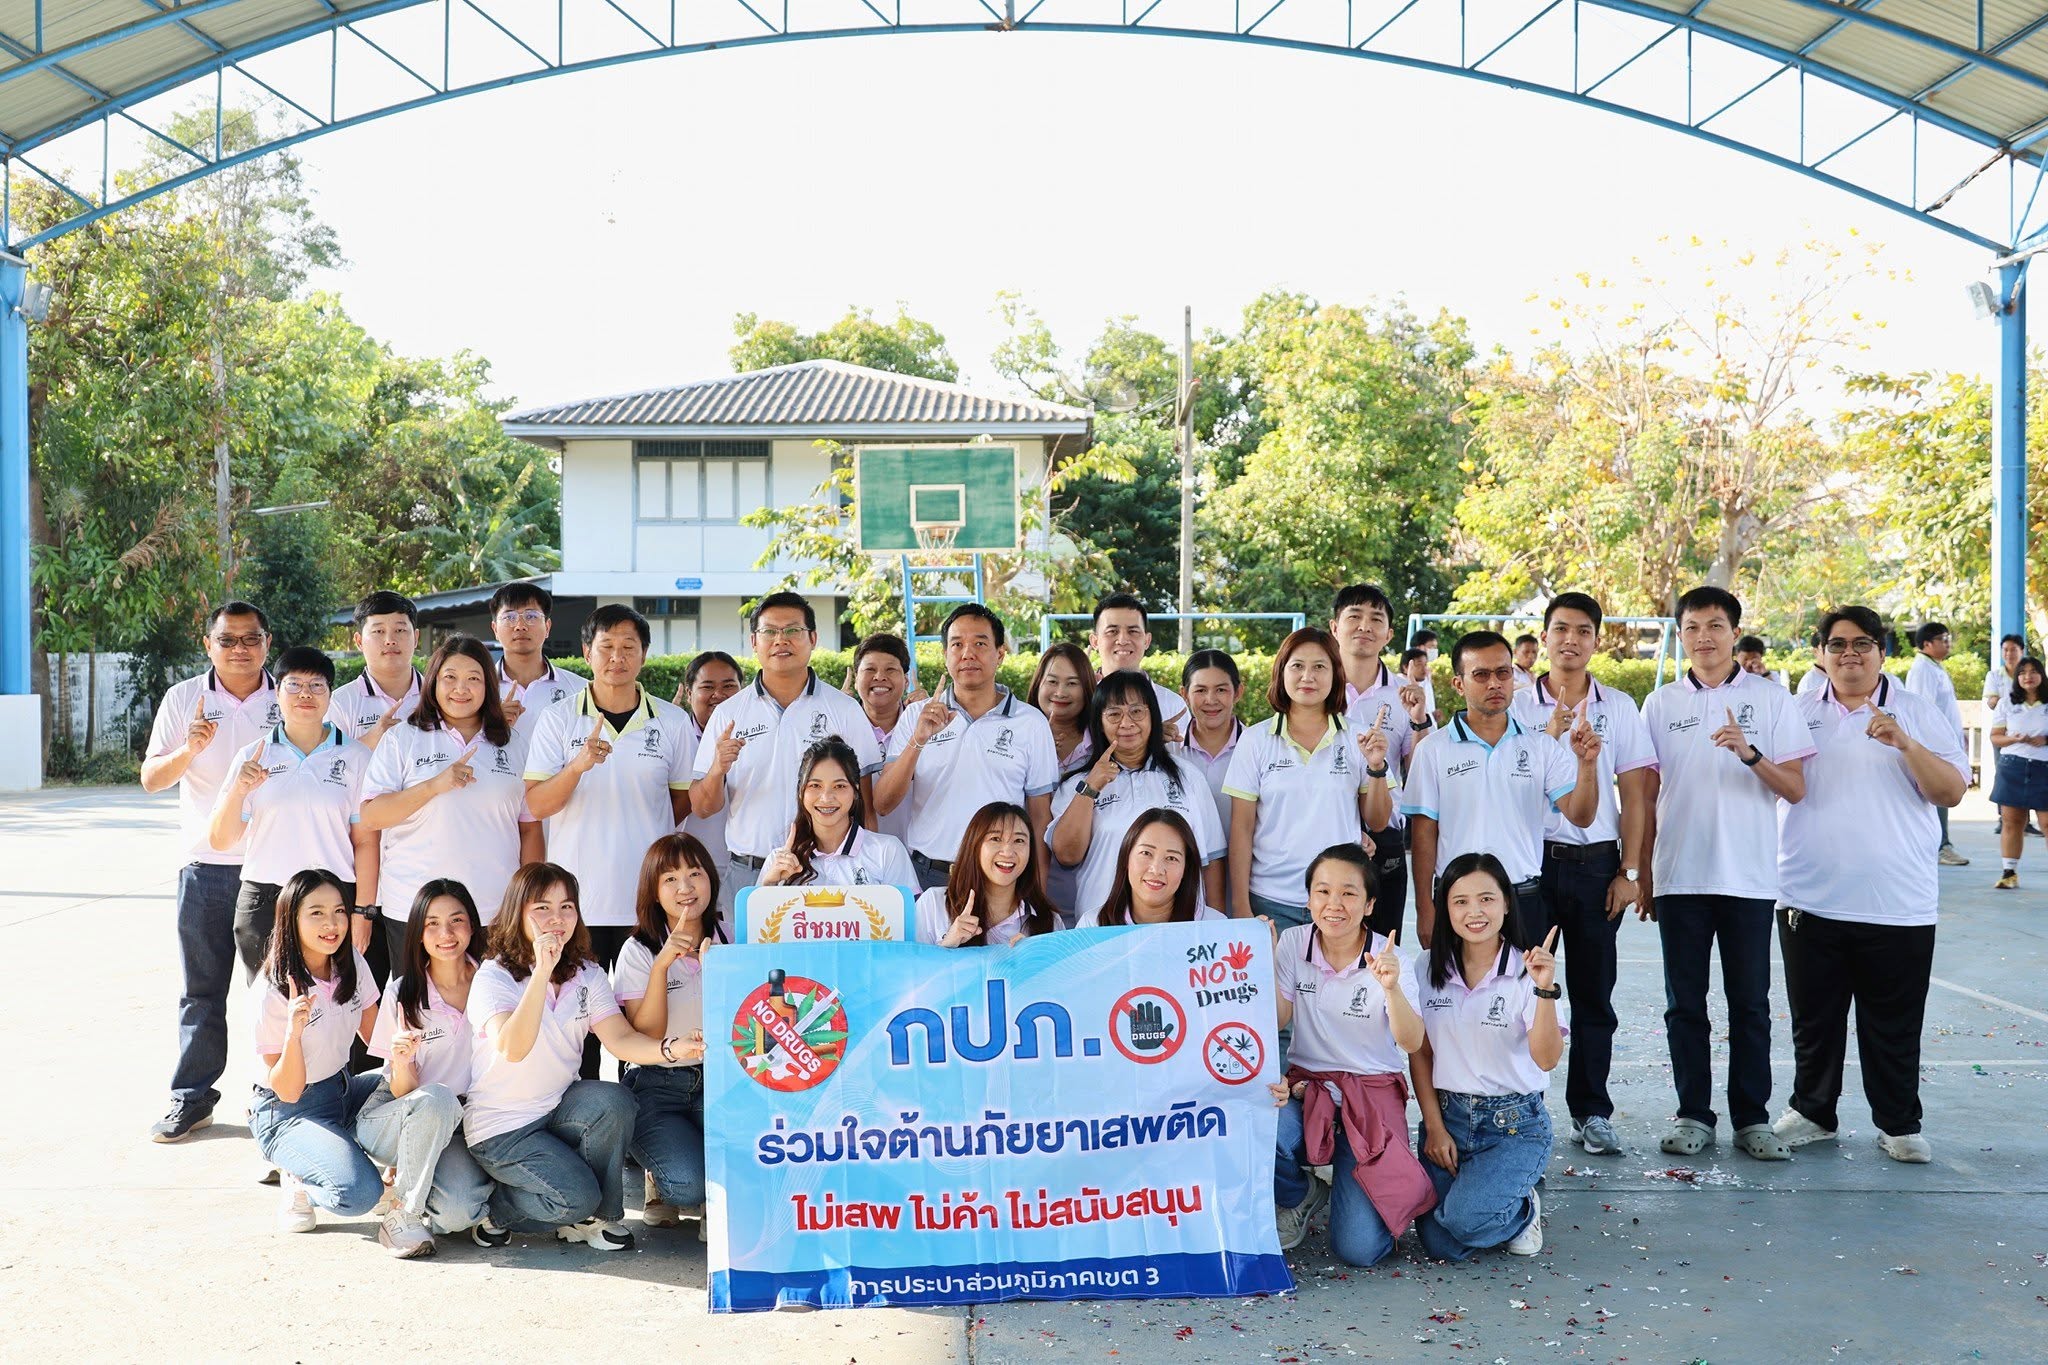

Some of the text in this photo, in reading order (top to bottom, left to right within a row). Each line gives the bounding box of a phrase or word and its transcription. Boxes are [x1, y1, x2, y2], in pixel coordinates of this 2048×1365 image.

[1186, 942, 1218, 963] SAY
[1189, 961, 1249, 988] NO to
[1195, 982, 1259, 1008] Drugs
[751, 999, 823, 1073] NO DRUGS
[886, 979, 1101, 1065] กปภ.
[1132, 1031, 1166, 1041] DRUGS
[757, 1100, 1228, 1165] ร่วมใจต้านภัยยาเสพติด
[791, 1184, 1203, 1231] ไม่เสพ ไม่ค้า ไม่สนับสนุน
[851, 1266, 1160, 1296] การประปาส่วนภูมิภาคเขต 3
